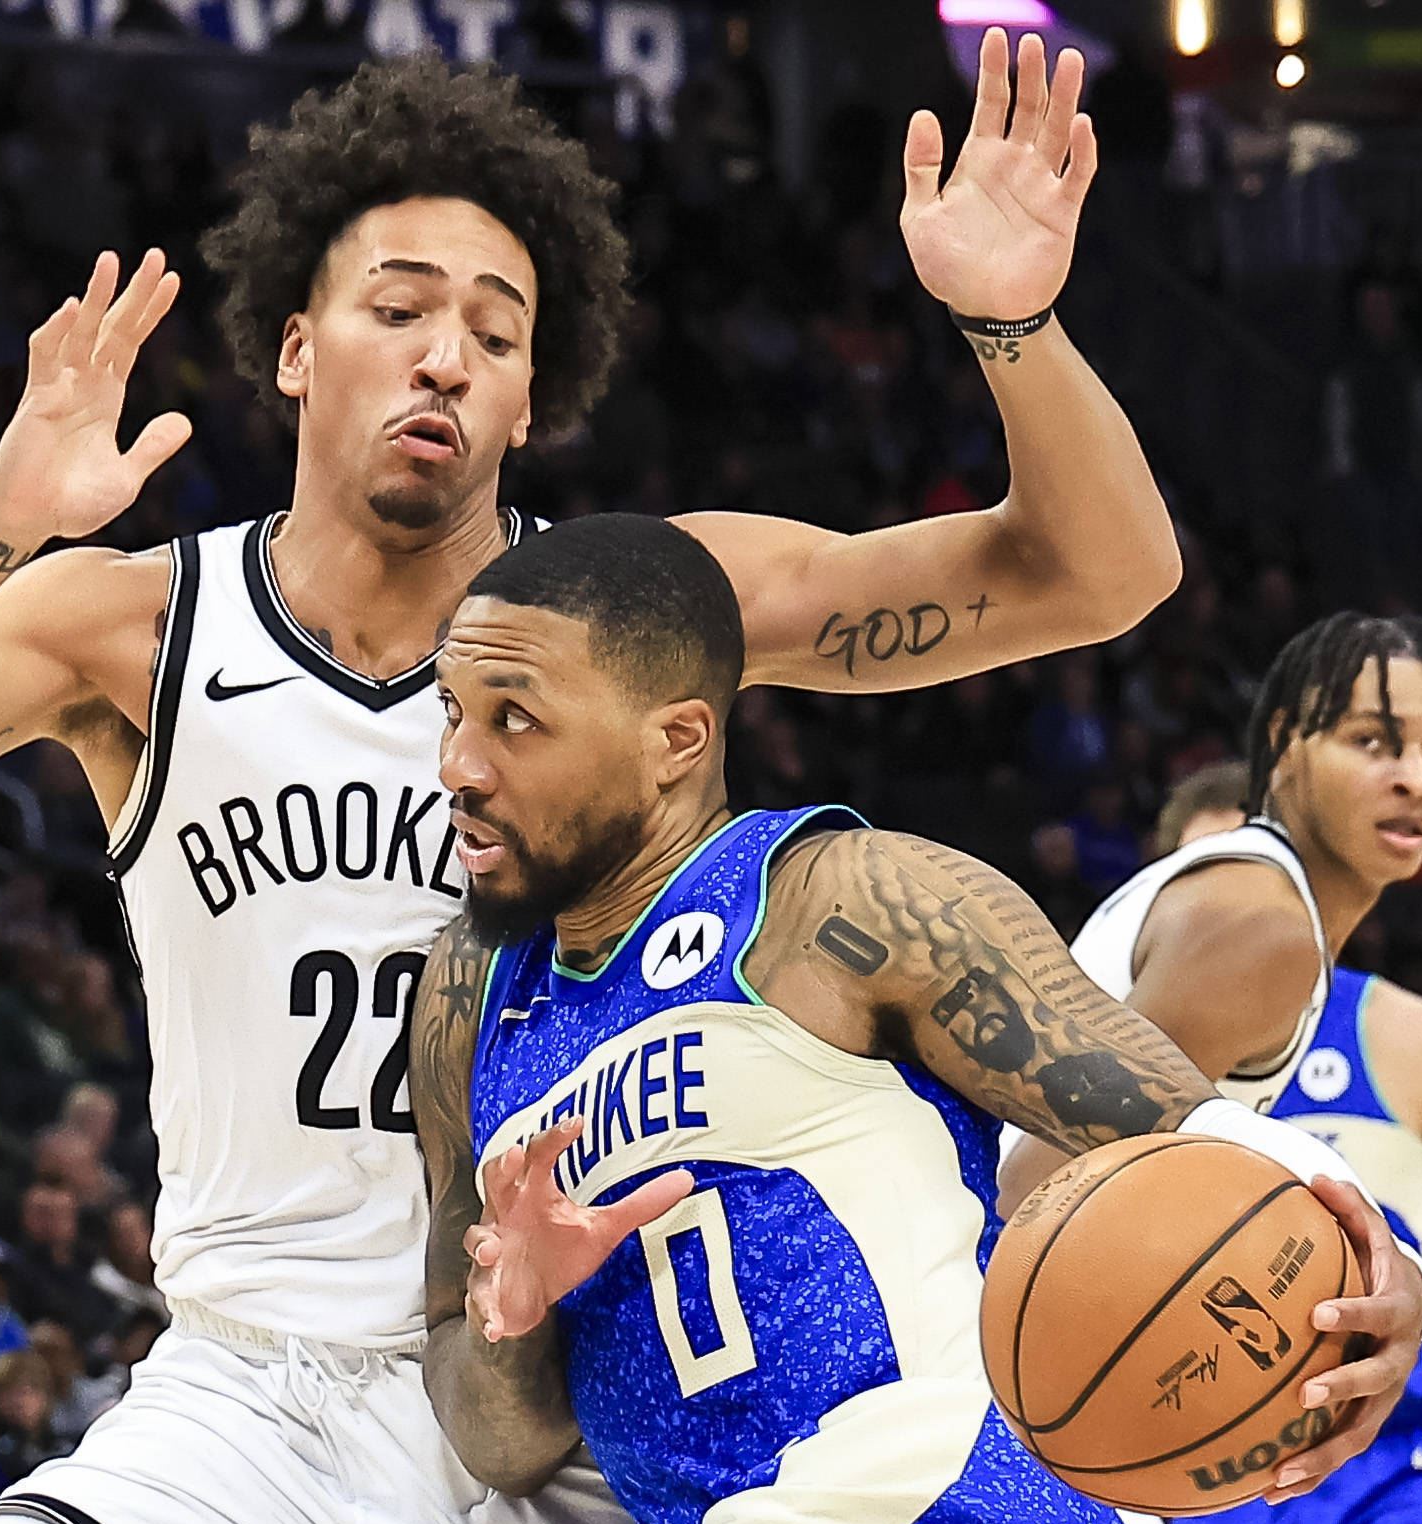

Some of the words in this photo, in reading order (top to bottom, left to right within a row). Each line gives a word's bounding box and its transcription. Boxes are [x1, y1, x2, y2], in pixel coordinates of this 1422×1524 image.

[178, 782, 464, 917] BROOKL
[289, 950, 417, 1134] 22
[638, 1186, 757, 1400] 0
